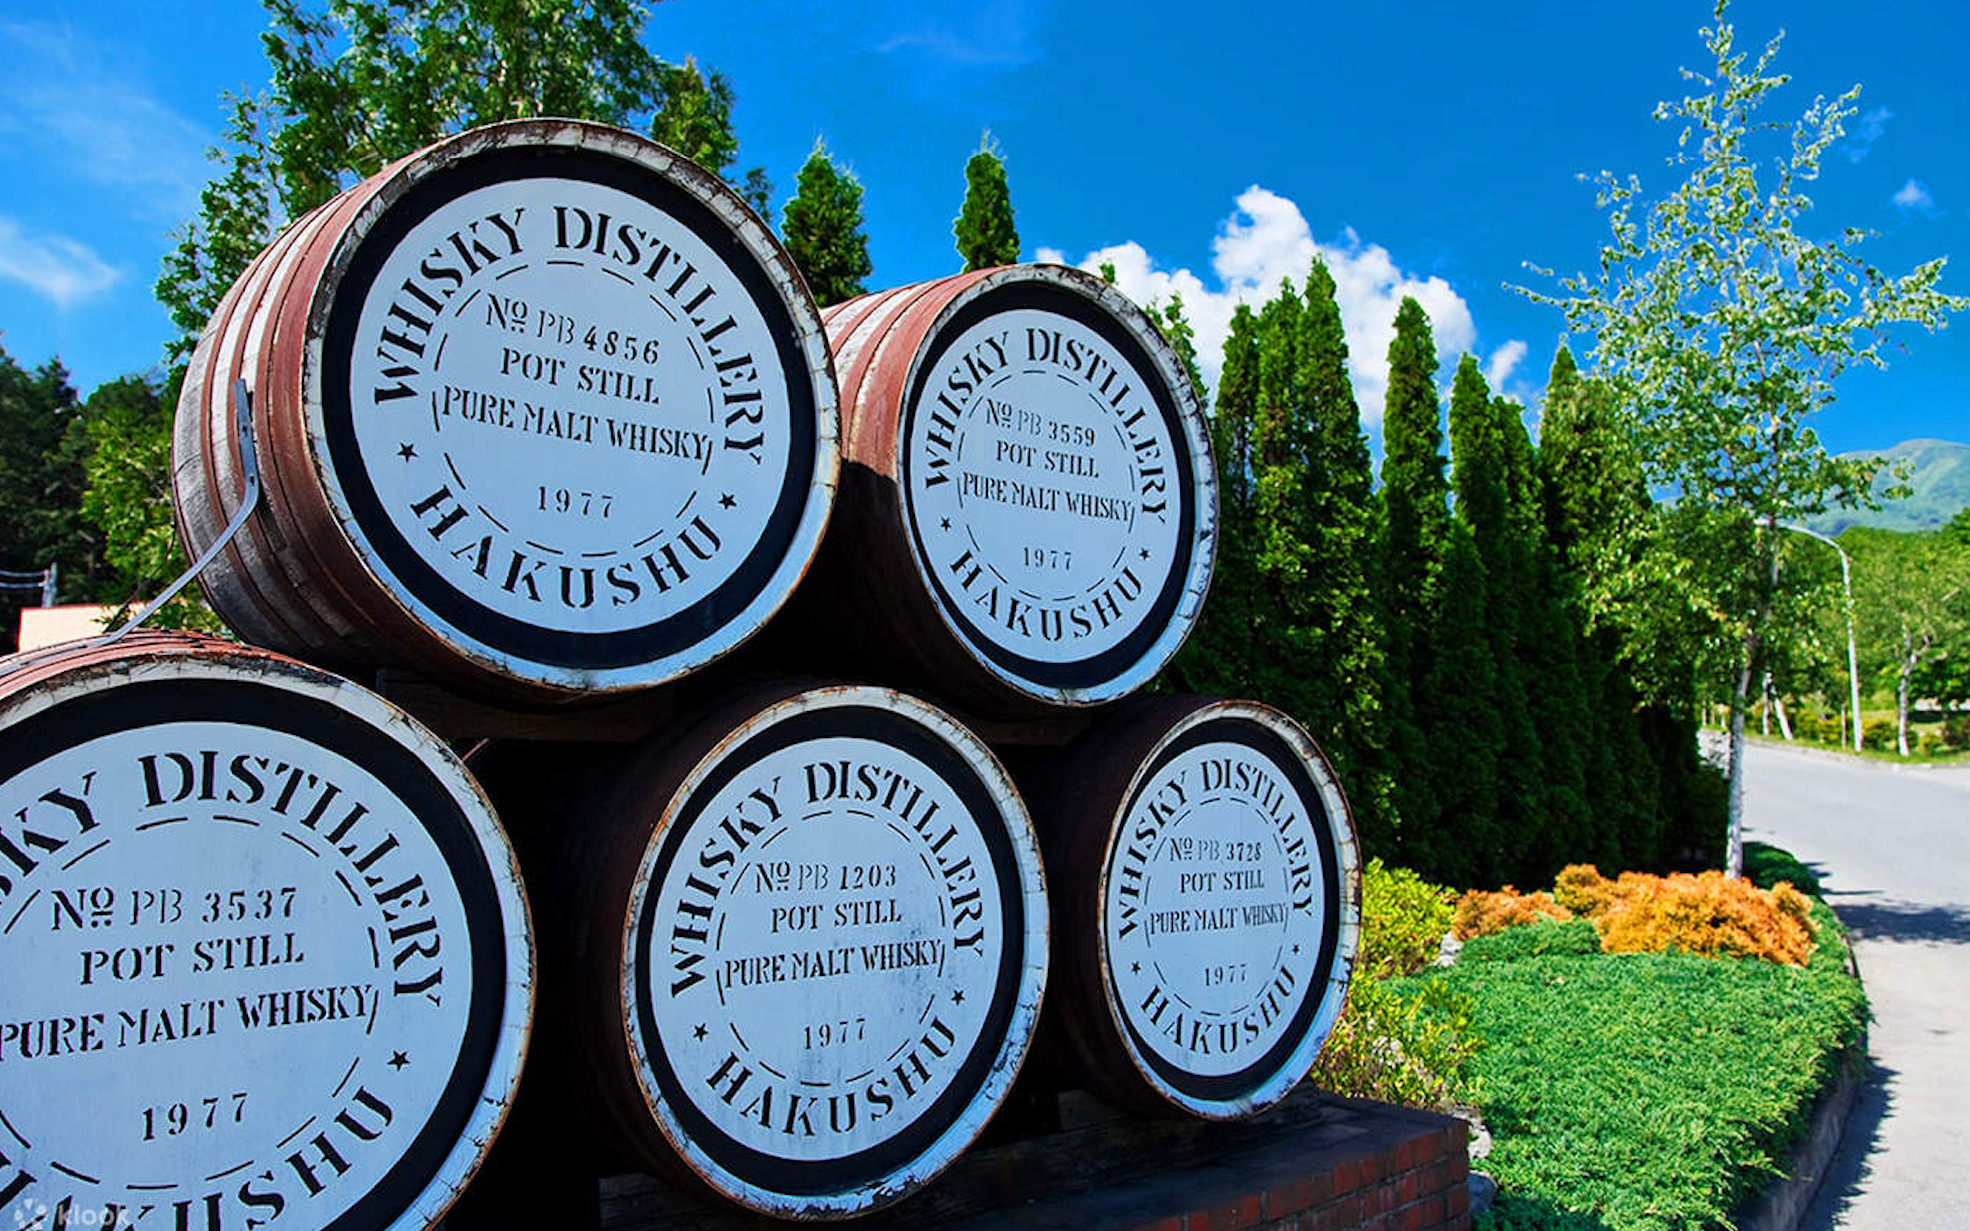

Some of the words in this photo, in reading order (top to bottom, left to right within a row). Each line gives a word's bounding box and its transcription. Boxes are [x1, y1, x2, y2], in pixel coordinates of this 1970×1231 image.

[374, 208, 525, 405] WHISKY
[554, 206, 764, 464] DISTILLERY
[538, 310, 574, 343] PB
[583, 325, 659, 364] 4856
[500, 349, 565, 384] POT
[577, 368, 660, 405] STILL
[442, 385, 514, 428] PURE
[522, 402, 598, 443] MALT
[606, 418, 707, 461] WHISKY
[925, 331, 1009, 489] WHISKY
[1026, 328, 1166, 524] DISTILLERY
[1017, 410, 1041, 436] PB
[1048, 421, 1095, 446] 3559
[997, 441, 1037, 469] POT
[1045, 451, 1099, 478] STILL
[537, 486, 614, 518] 1977
[962, 472, 1008, 504] PURE
[1011, 482, 1061, 511] MALT
[1066, 491, 1130, 522] WHISKY
[411, 484, 722, 608] HAKUSHU
[1023, 547, 1072, 570] 1977
[950, 549, 1142, 641] HAKUSHU
[1118, 770, 1188, 940] WHISKY
[1201, 759, 1312, 918] DISTILLERY
[1198, 840, 1219, 861] PB
[1226, 842, 1262, 861] 3728
[0, 771, 101, 903] KY
[138, 751, 444, 1007] DISTILLERY
[670, 776, 784, 997] WHISKY
[803, 760, 984, 957] DISTILLERY
[798, 863, 828, 890] PB
[840, 864, 896, 889] 1203
[1180, 873, 1217, 893] POT
[1223, 869, 1265, 890] STILL
[131, 890, 182, 924] PB
[202, 887, 297, 922] 3537
[771, 905, 823, 933] POT
[834, 898, 902, 927] STILL
[1150, 911, 1191, 934] PURE
[1194, 908, 1238, 931] MALT
[1243, 903, 1286, 926] WHISKY
[80, 944, 174, 985] POT
[193, 932, 304, 973] STILL
[725, 955, 785, 988] PURE
[791, 948, 855, 981] MALT
[861, 940, 941, 971] WHISKY
[1203, 964, 1248, 986] 1977
[0, 1014, 104, 1061] PURE
[117, 1000, 226, 1047] MALT
[237, 984, 372, 1028] WHISKY
[803, 1018, 867, 1049] 1977
[1140, 966, 1297, 1054] HAKUSHU
[706, 1019, 957, 1136] HAKUSHU
[142, 1093, 248, 1141] 1977
